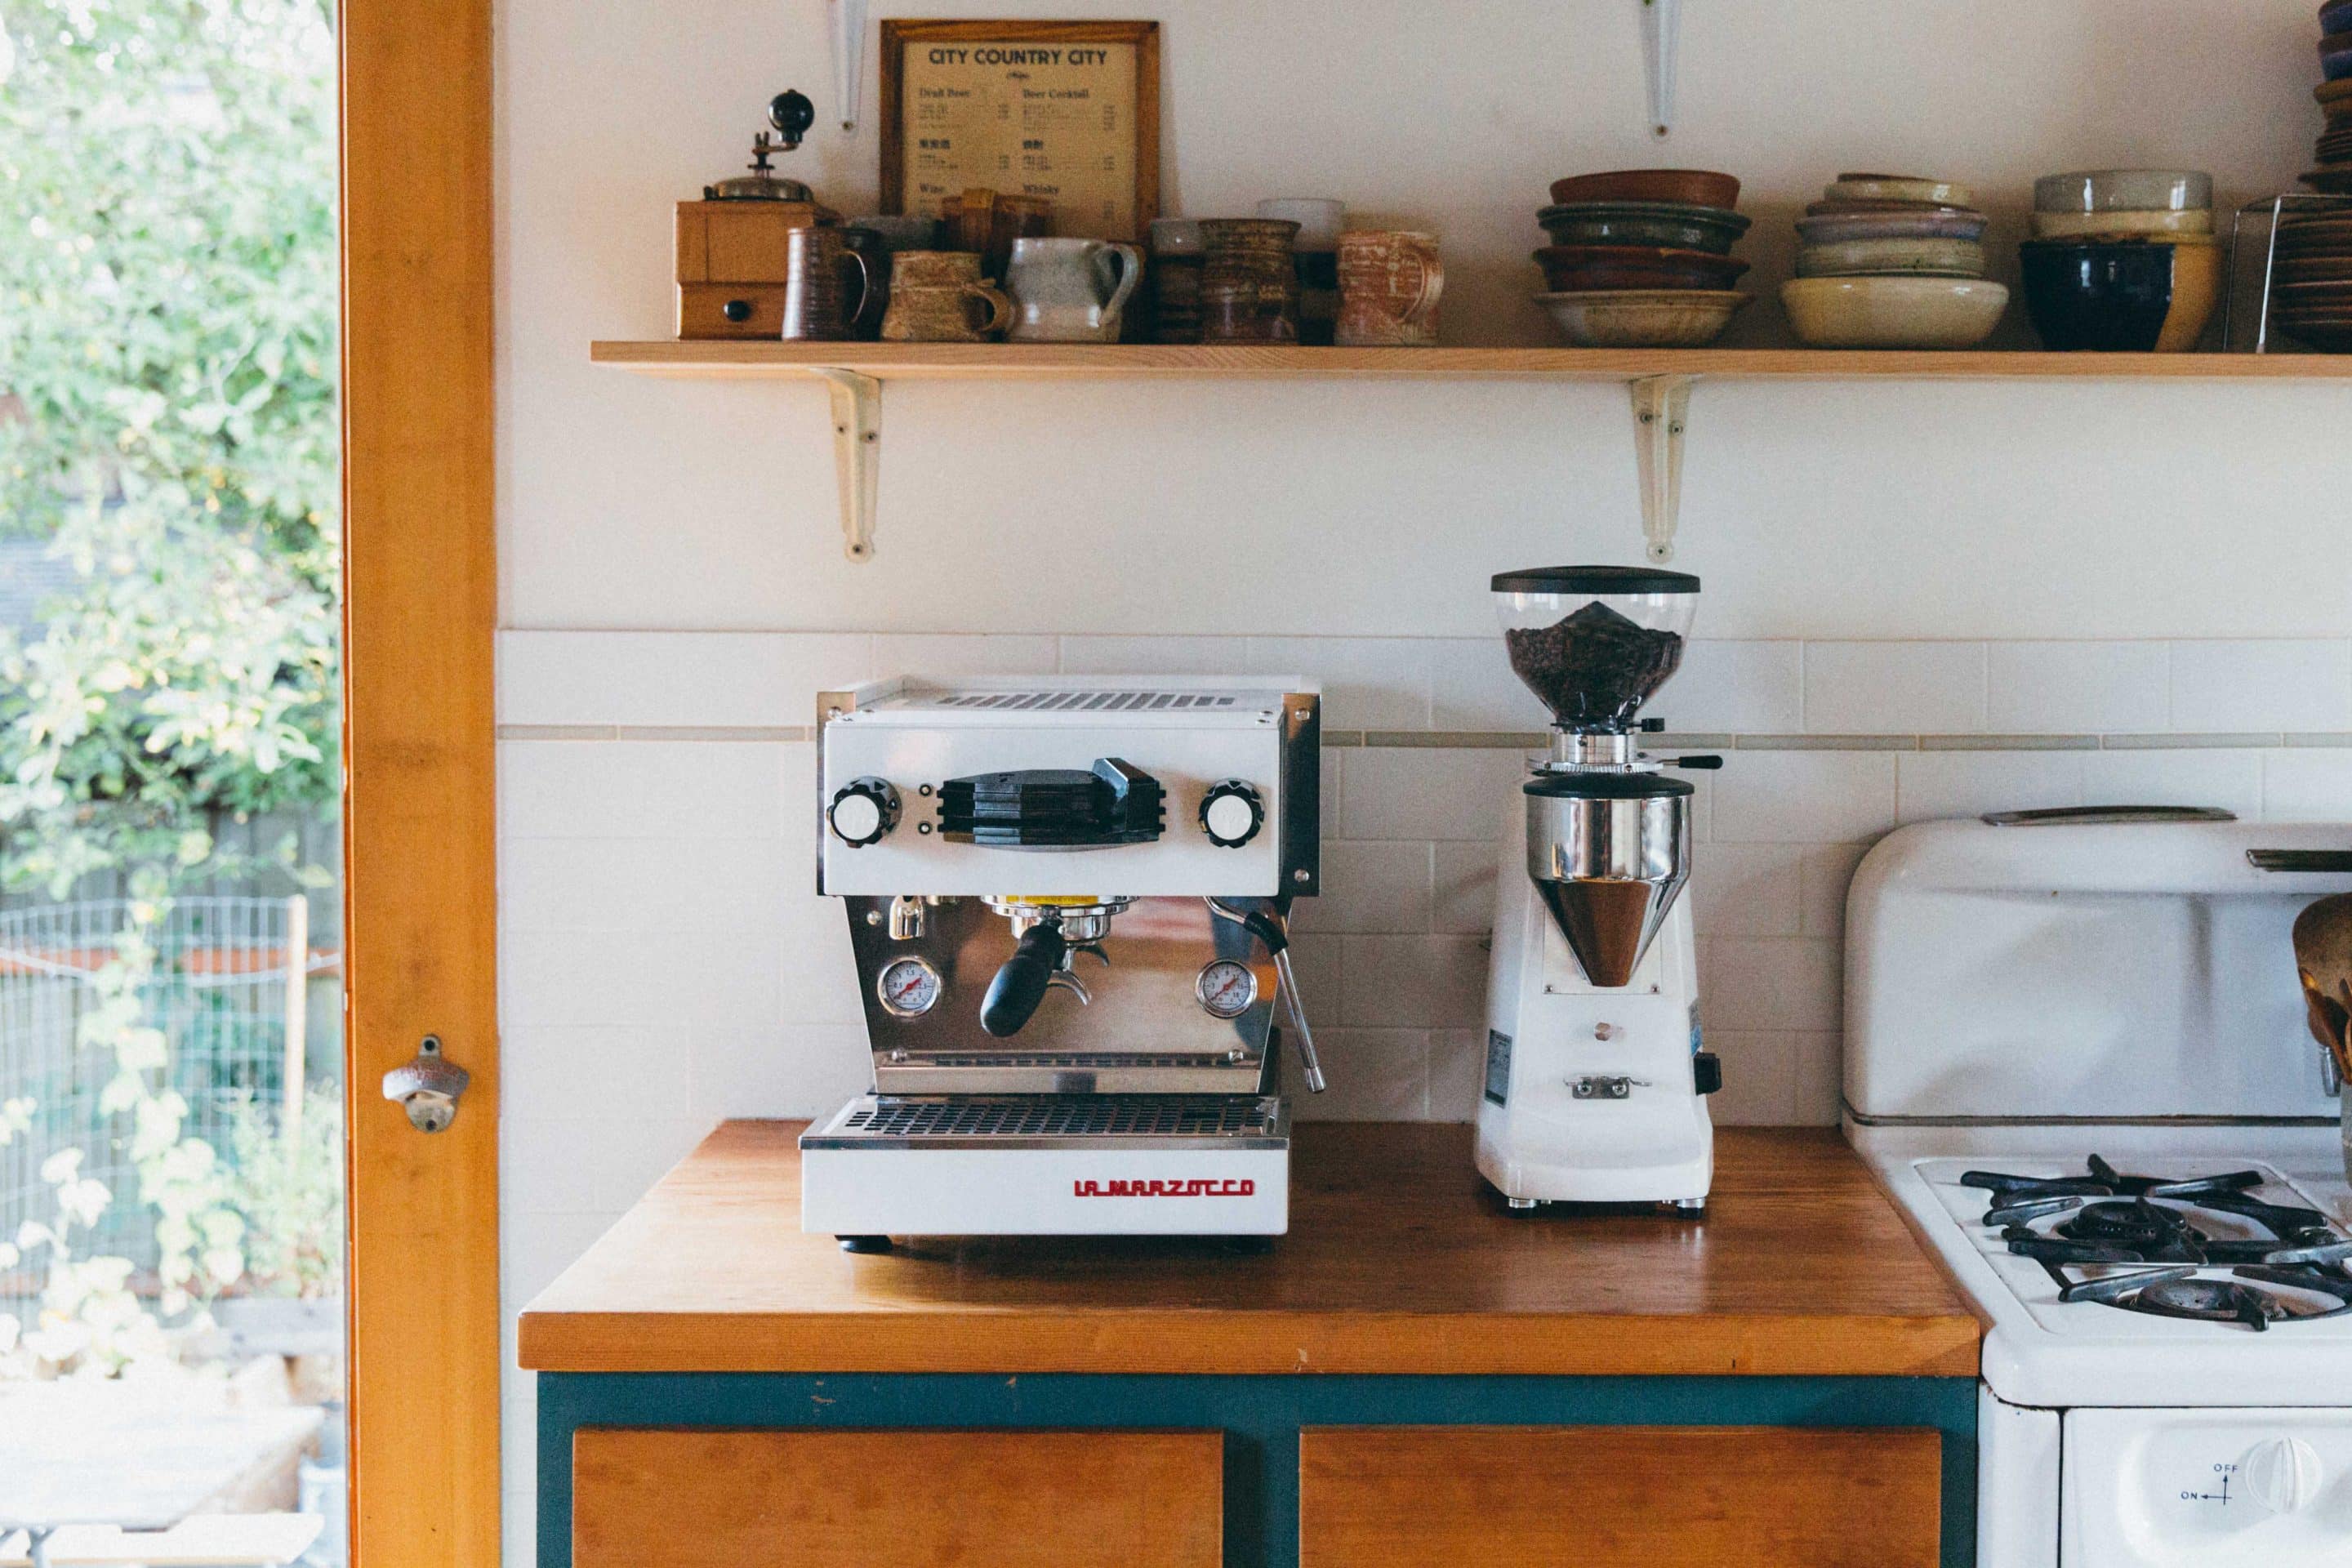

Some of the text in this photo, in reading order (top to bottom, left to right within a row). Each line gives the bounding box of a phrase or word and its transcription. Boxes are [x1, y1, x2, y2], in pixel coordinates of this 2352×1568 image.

[929, 48, 1107, 65] CITY COUNTRY CITY
[2213, 1463, 2238, 1472] OFF
[2180, 1490, 2198, 1500] ON
